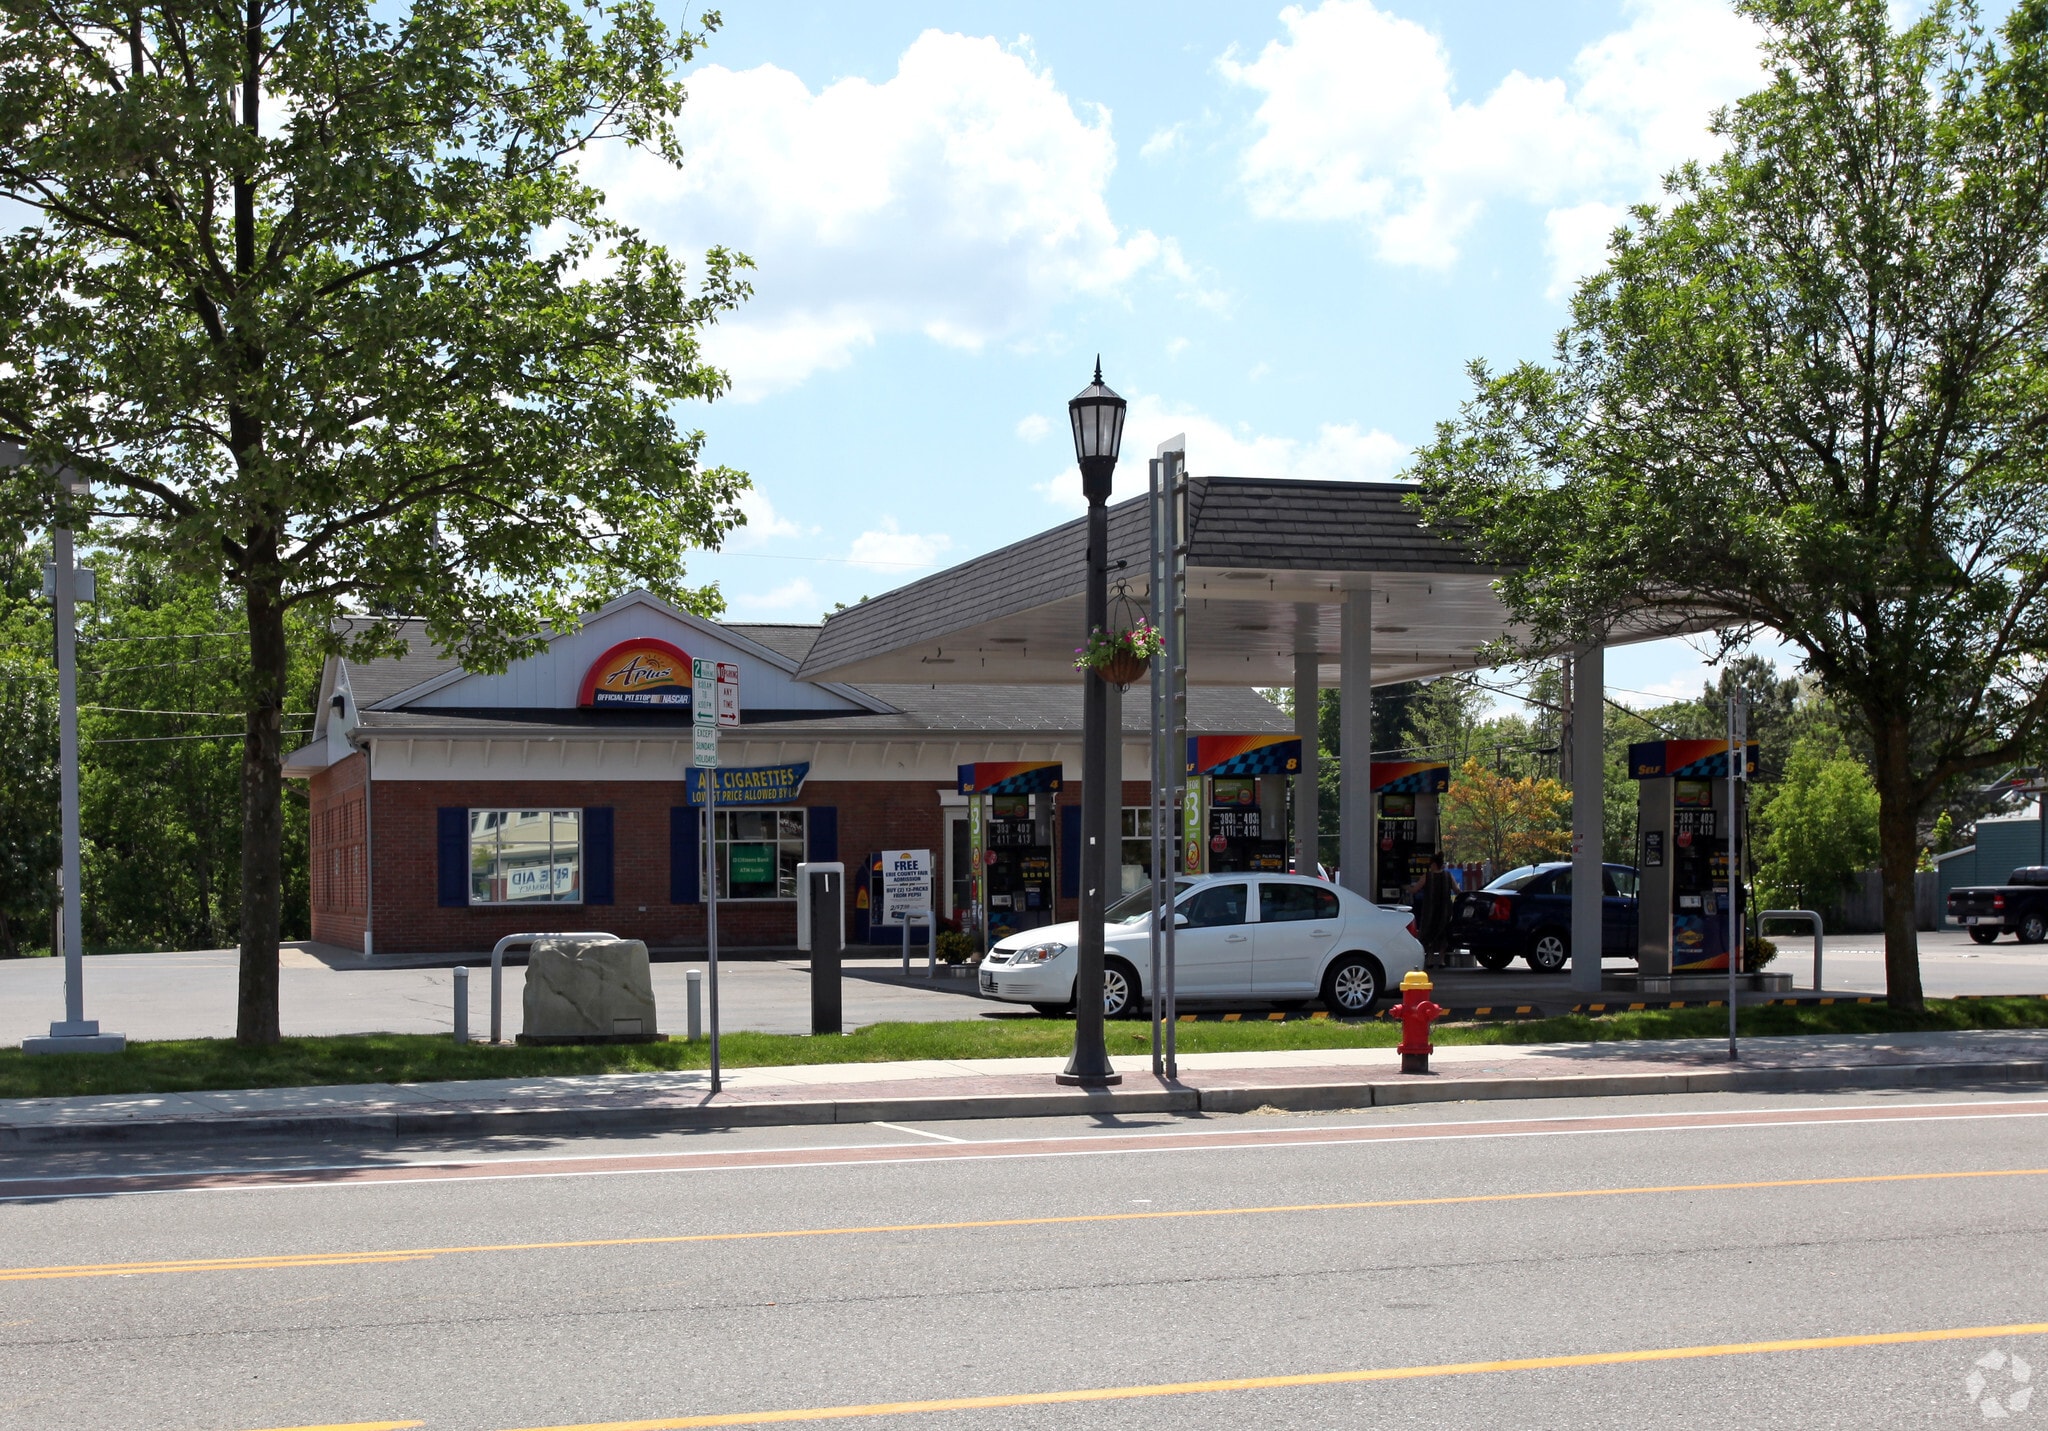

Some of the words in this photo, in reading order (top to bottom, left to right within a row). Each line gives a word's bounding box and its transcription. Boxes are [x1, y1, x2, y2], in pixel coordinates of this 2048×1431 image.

[695, 661, 700, 677] 2
[597, 693, 623, 701] OFFICIAL
[723, 687, 733, 697] ANY
[662, 694, 689, 704] NASCAR
[723, 699, 734, 710] TIME
[697, 728, 713, 738] EXCEPT
[695, 740, 715, 751] SUNDAYS
[695, 754, 716, 764] HOLIDAYS
[1287, 759, 1297, 770] 8
[1746, 762, 1756, 773] 6
[698, 772, 720, 789] AL
[724, 768, 794, 788] CIGARETTES
[1050, 781, 1059, 789] 4
[1437, 781, 1446, 789] 2
[692, 791, 721, 803] LOWST
[722, 790, 743, 801] PRICE
[744, 788, 777, 800] ALLOWED
[779, 787, 788, 798] BY
[1220, 812, 1233, 825] 393
[1243, 812, 1257, 825] 403
[1243, 825, 1257, 837] 413
[894, 860, 919, 871] FREE
